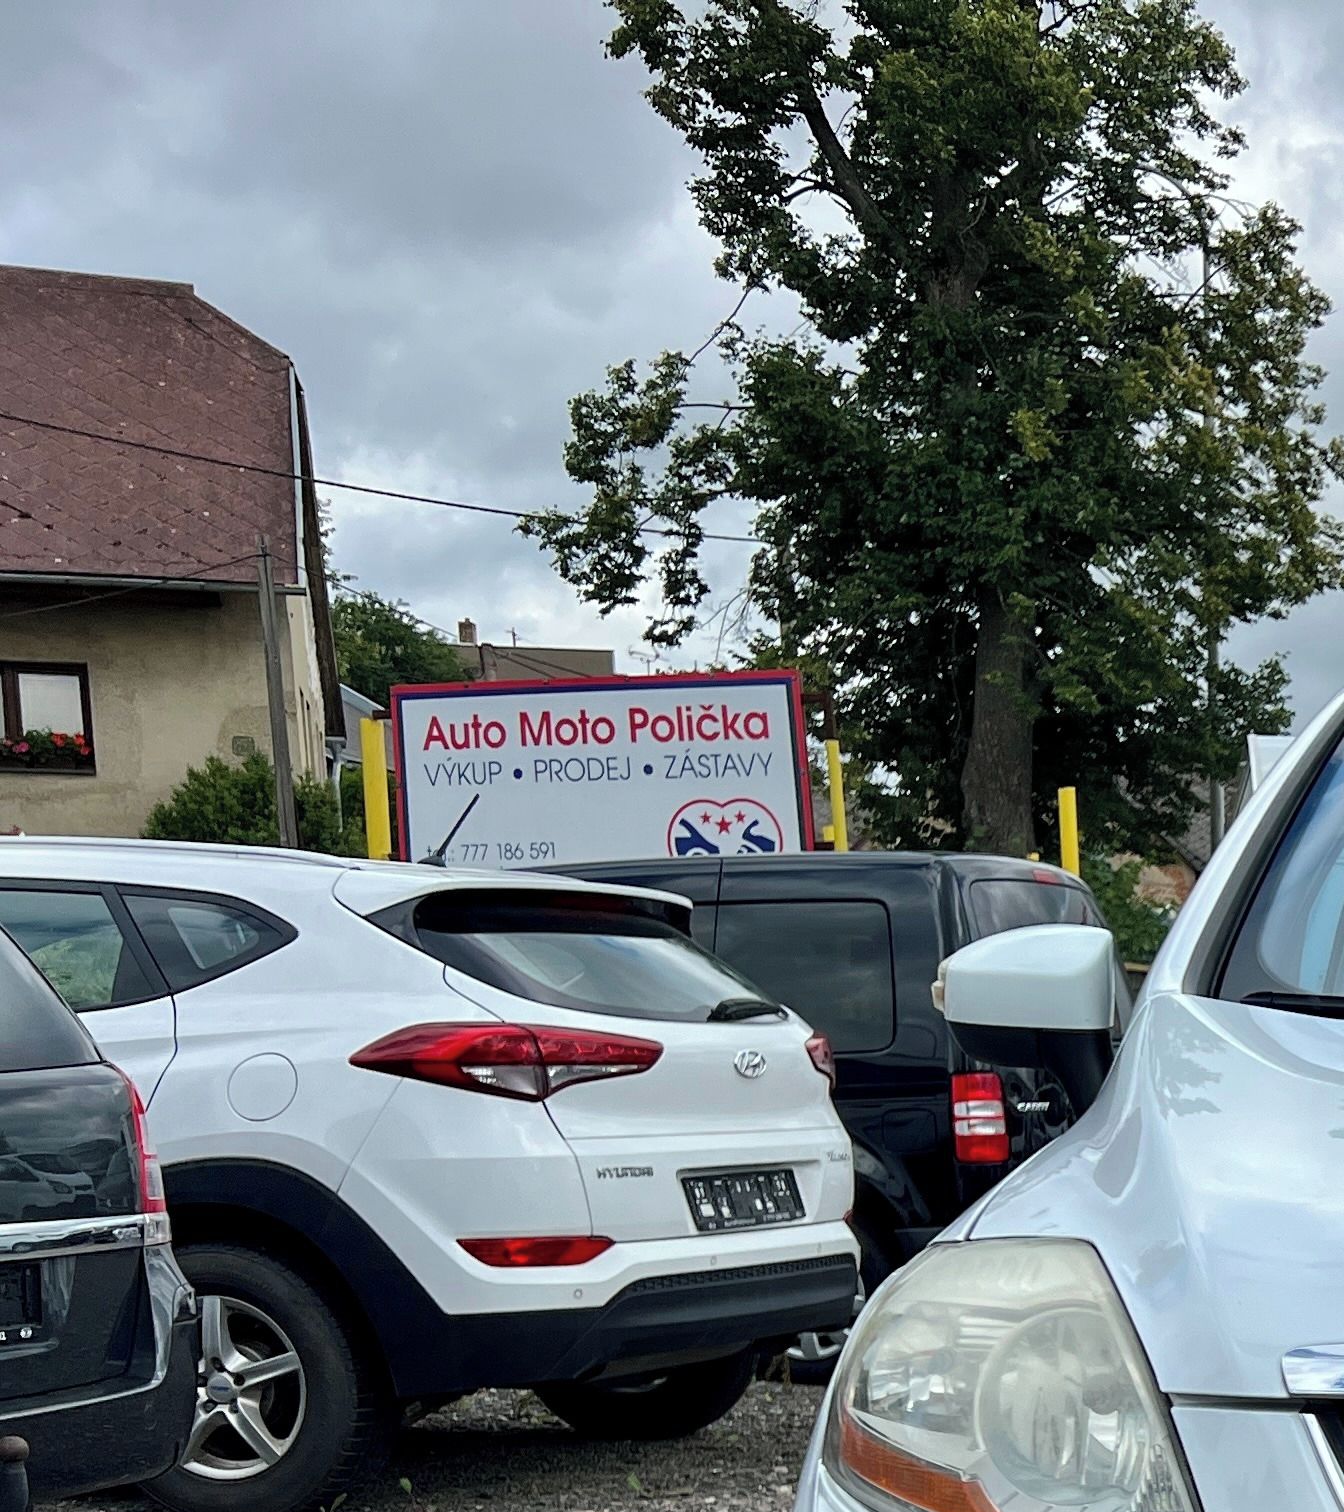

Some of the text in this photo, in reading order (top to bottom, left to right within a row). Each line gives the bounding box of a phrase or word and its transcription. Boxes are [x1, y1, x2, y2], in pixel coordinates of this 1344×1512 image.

[423, 703, 770, 751] Auto Moto Polička
[423, 748, 773, 787] VÝKUP PRODEJ ZÁSTAVY
[460, 844, 489, 862] 777
[496, 842, 525, 861] 186
[529, 841, 556, 860] 591
